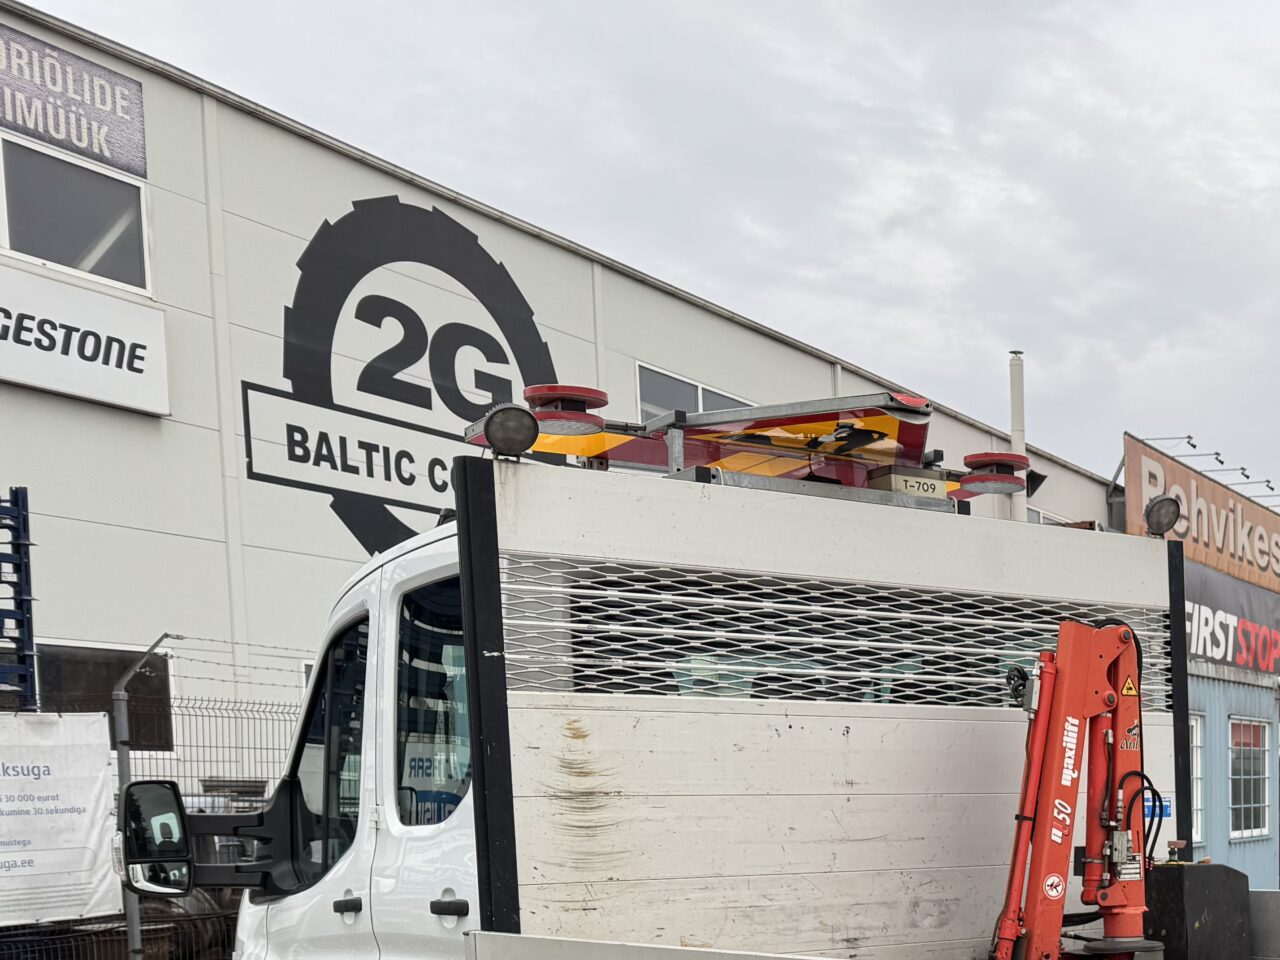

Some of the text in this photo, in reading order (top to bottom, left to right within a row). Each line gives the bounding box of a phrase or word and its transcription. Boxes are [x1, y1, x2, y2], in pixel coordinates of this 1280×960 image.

[354, 294, 513, 424] 2G
[286, 423, 456, 493] BALTIC C
[902, 479, 936, 494] T-709
[1061, 716, 1080, 787] maxilift
[0, 762, 51, 780] ksuga
[4, 793, 60, 803] 30 000 eurot
[32, 807, 43, 816] 30
